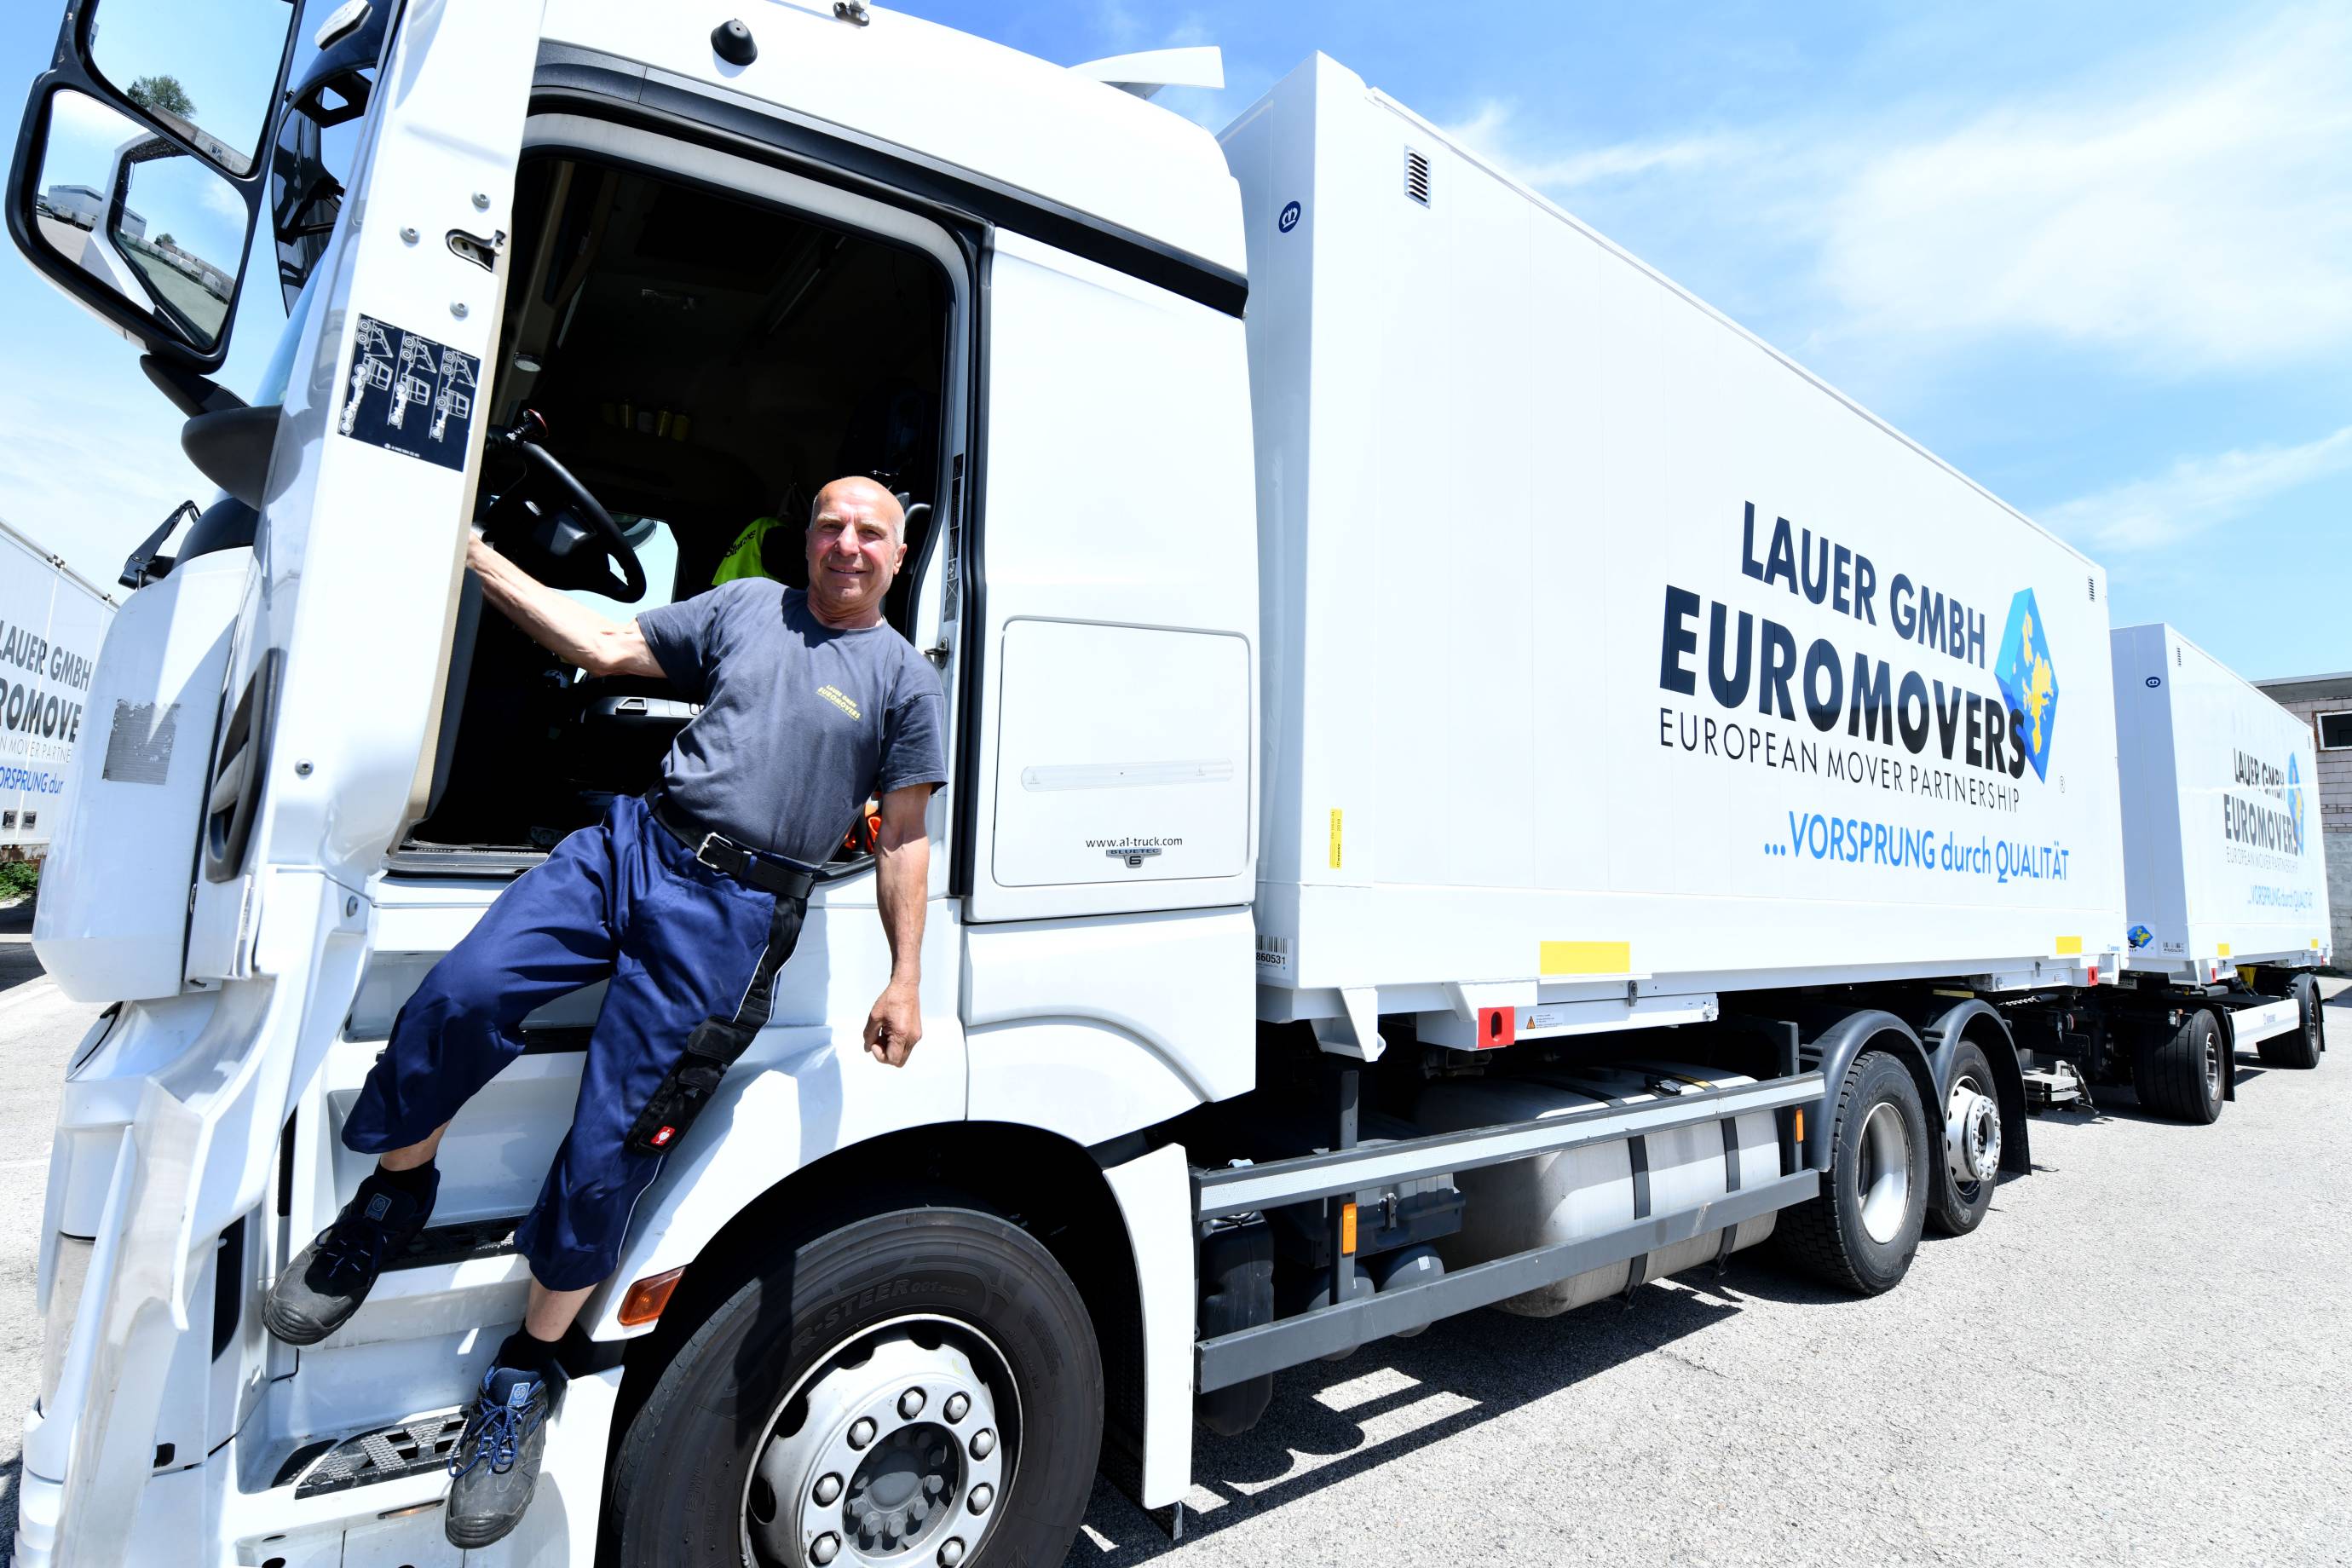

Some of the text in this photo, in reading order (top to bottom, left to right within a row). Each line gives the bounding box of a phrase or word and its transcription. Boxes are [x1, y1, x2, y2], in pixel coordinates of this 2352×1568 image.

[1741, 499, 1986, 670] LAUER GMBH
[49, 646, 93, 692] GMBH
[1660, 584, 2026, 780] EUROMOVERS
[1660, 707, 2020, 813] EUROPEAN MOVER PARTNERSHIP
[2234, 747, 2260, 792] LAUER
[1085, 836, 1183, 848] www.a1-truck.com
[2223, 793, 2299, 857] EUROMOVERS
[1129, 856, 1142, 865] 6
[1941, 833, 1992, 875] durch
[1997, 839, 2070, 884] QUALITÄT
